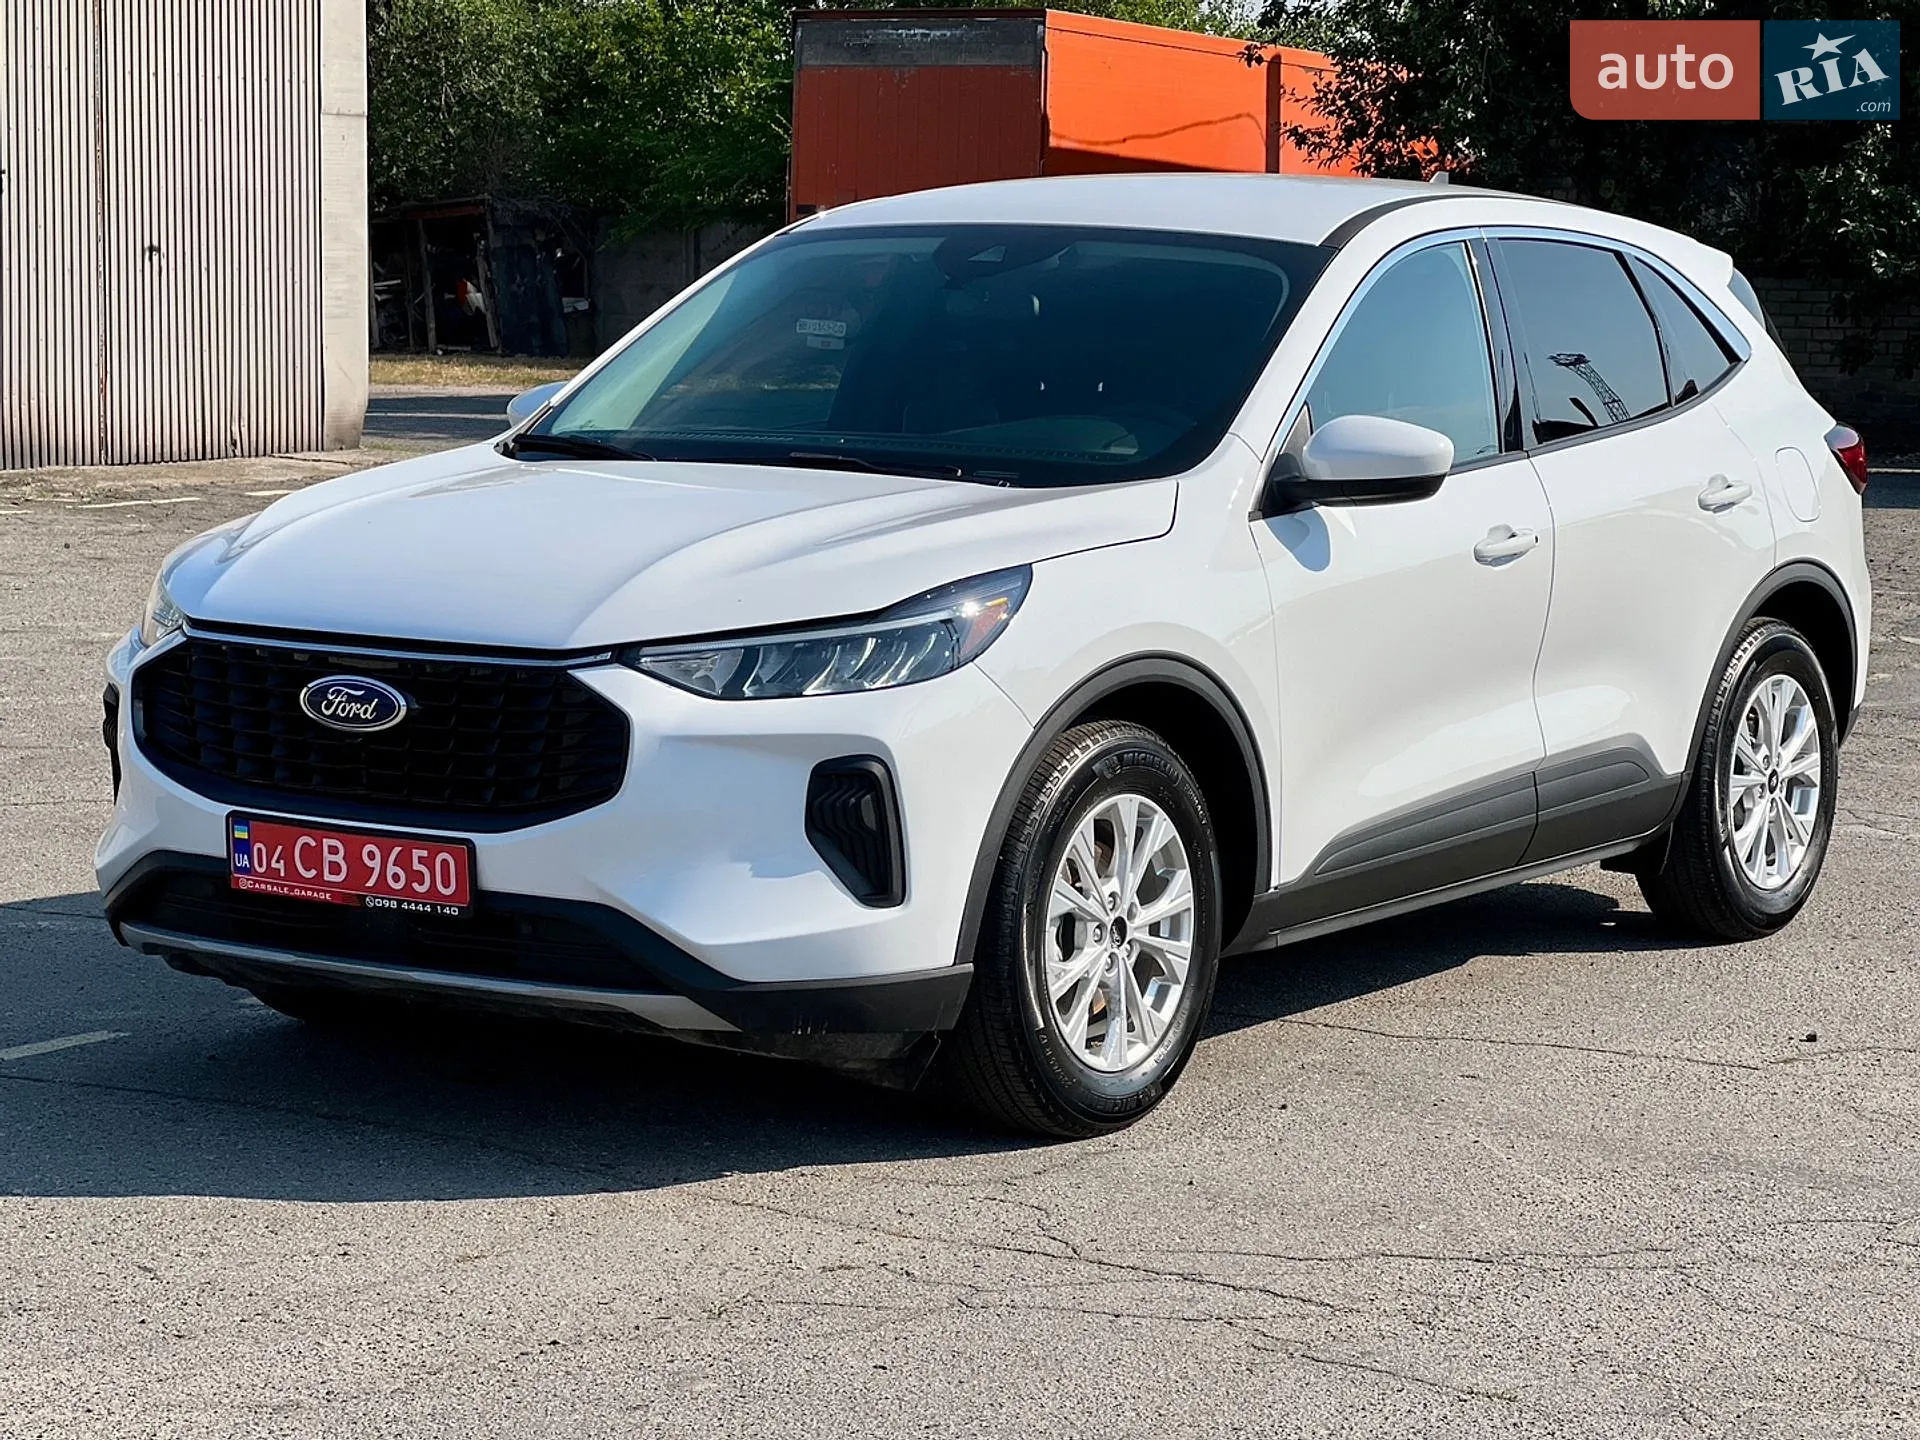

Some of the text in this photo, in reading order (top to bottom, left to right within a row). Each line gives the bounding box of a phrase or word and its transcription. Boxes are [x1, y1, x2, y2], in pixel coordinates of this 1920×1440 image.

[321, 686, 378, 719] Ford
[234, 853, 250, 868] UA
[253, 835, 456, 896] 04 CB 9650
[401, 901, 431, 913] 4444
[437, 905, 459, 915] 140
